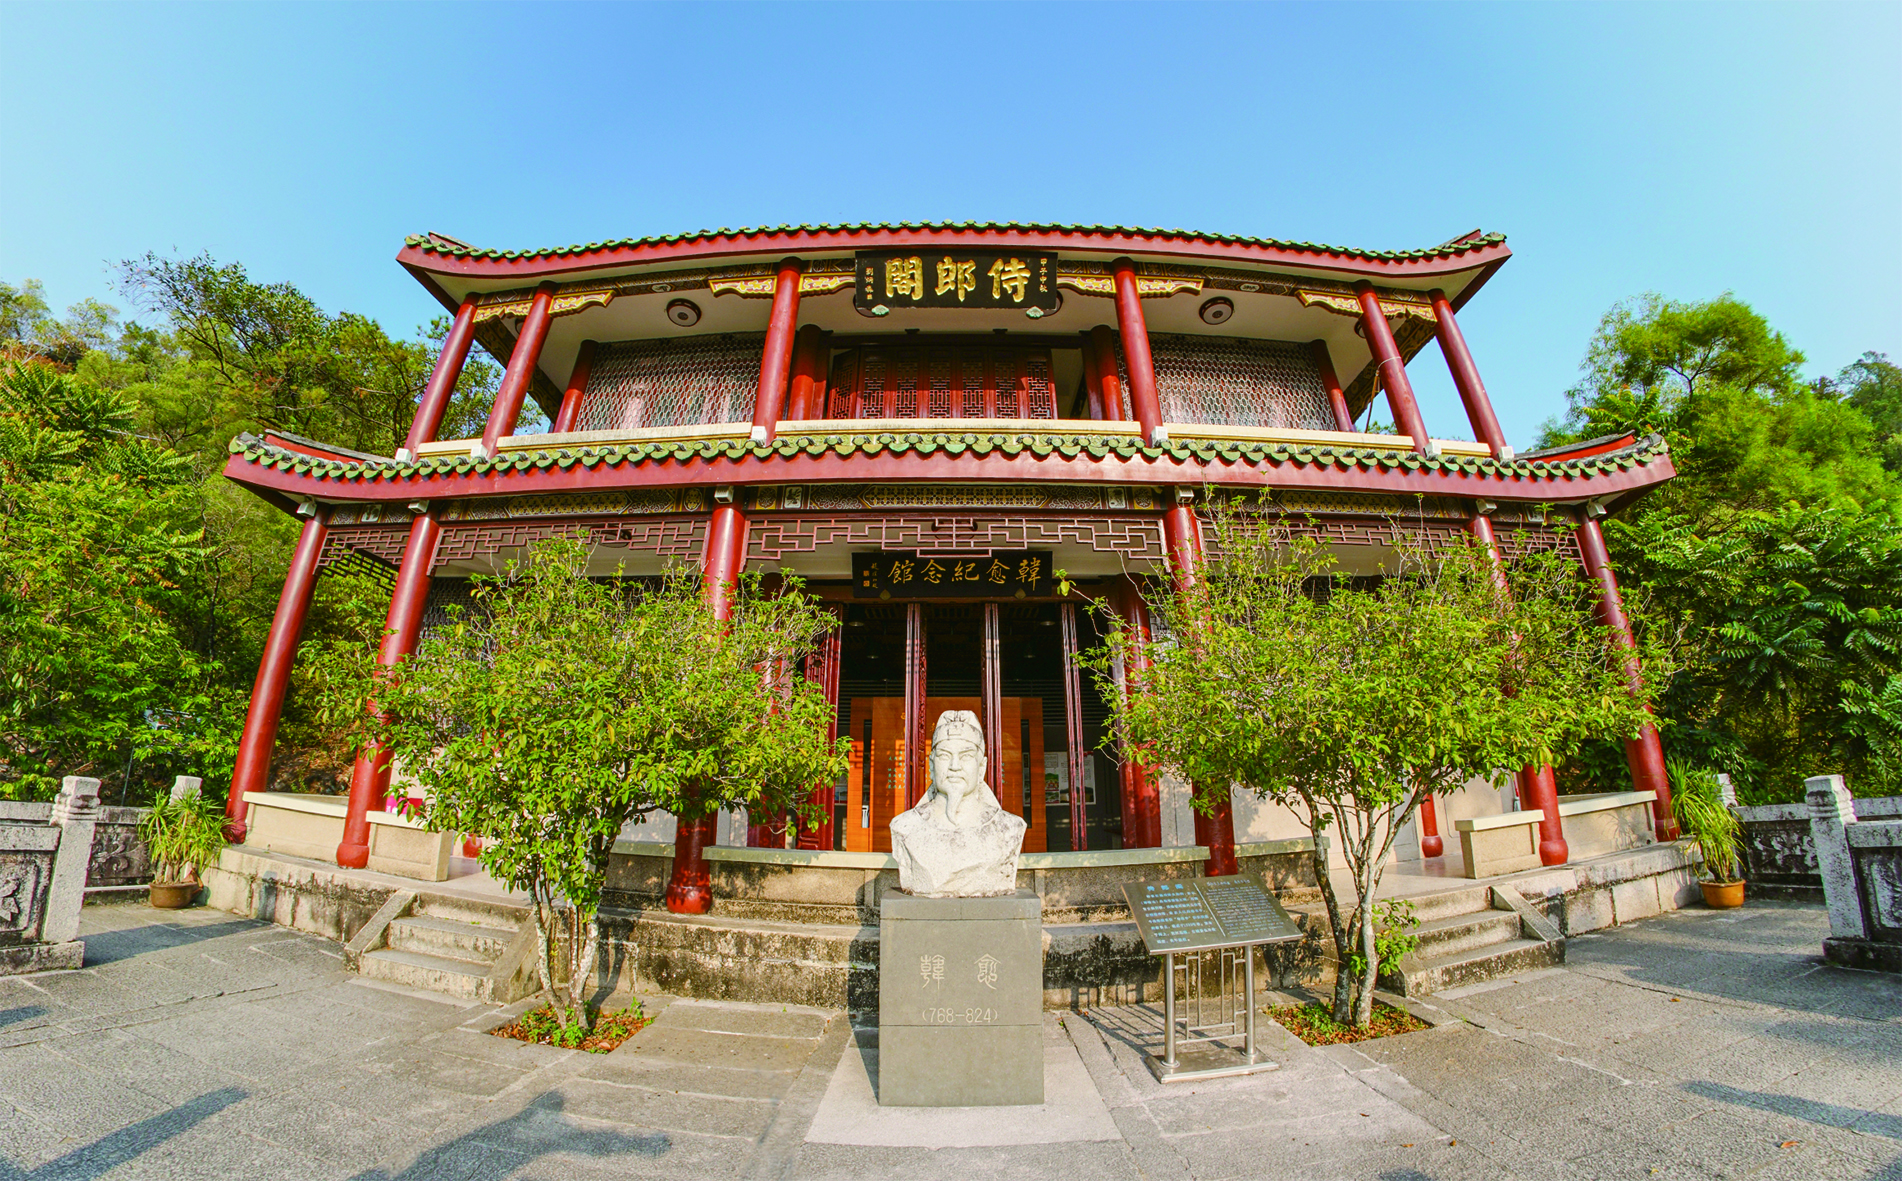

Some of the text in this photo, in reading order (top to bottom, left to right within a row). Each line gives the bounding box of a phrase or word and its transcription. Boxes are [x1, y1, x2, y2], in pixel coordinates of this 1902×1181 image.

[885, 256, 1031, 303] 侍郎閣
[887, 557, 1042, 591] 韓愈紀念館
